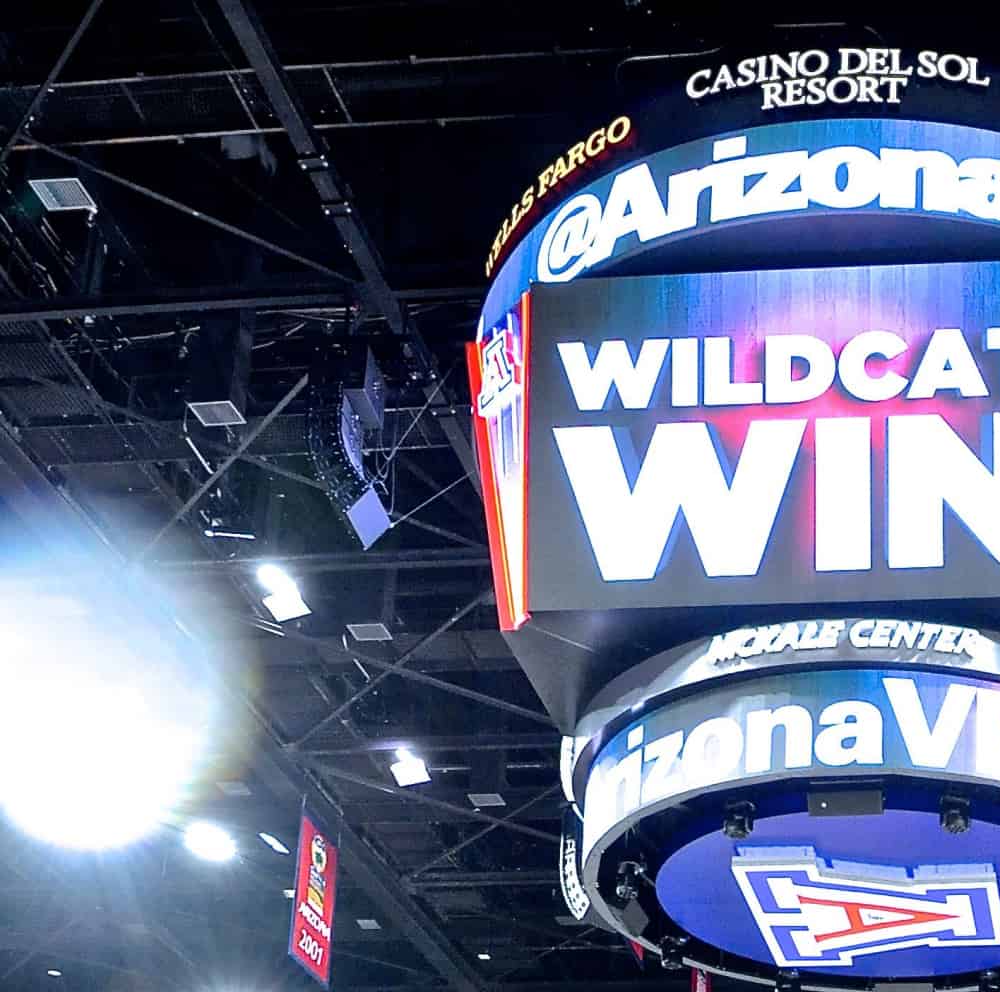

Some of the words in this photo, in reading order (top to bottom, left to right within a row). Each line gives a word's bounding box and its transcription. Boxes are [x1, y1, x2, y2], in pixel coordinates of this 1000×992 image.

[686, 50, 829, 99] CASINO
[838, 47, 913, 76] DEL
[916, 51, 991, 87] SOL
[761, 76, 908, 110] RESORT
[537, 115, 631, 198] FARGO
[849, 619, 985, 655] CENTER
[299, 901, 331, 941] ARIZONA
[299, 929, 325, 966] 2001
